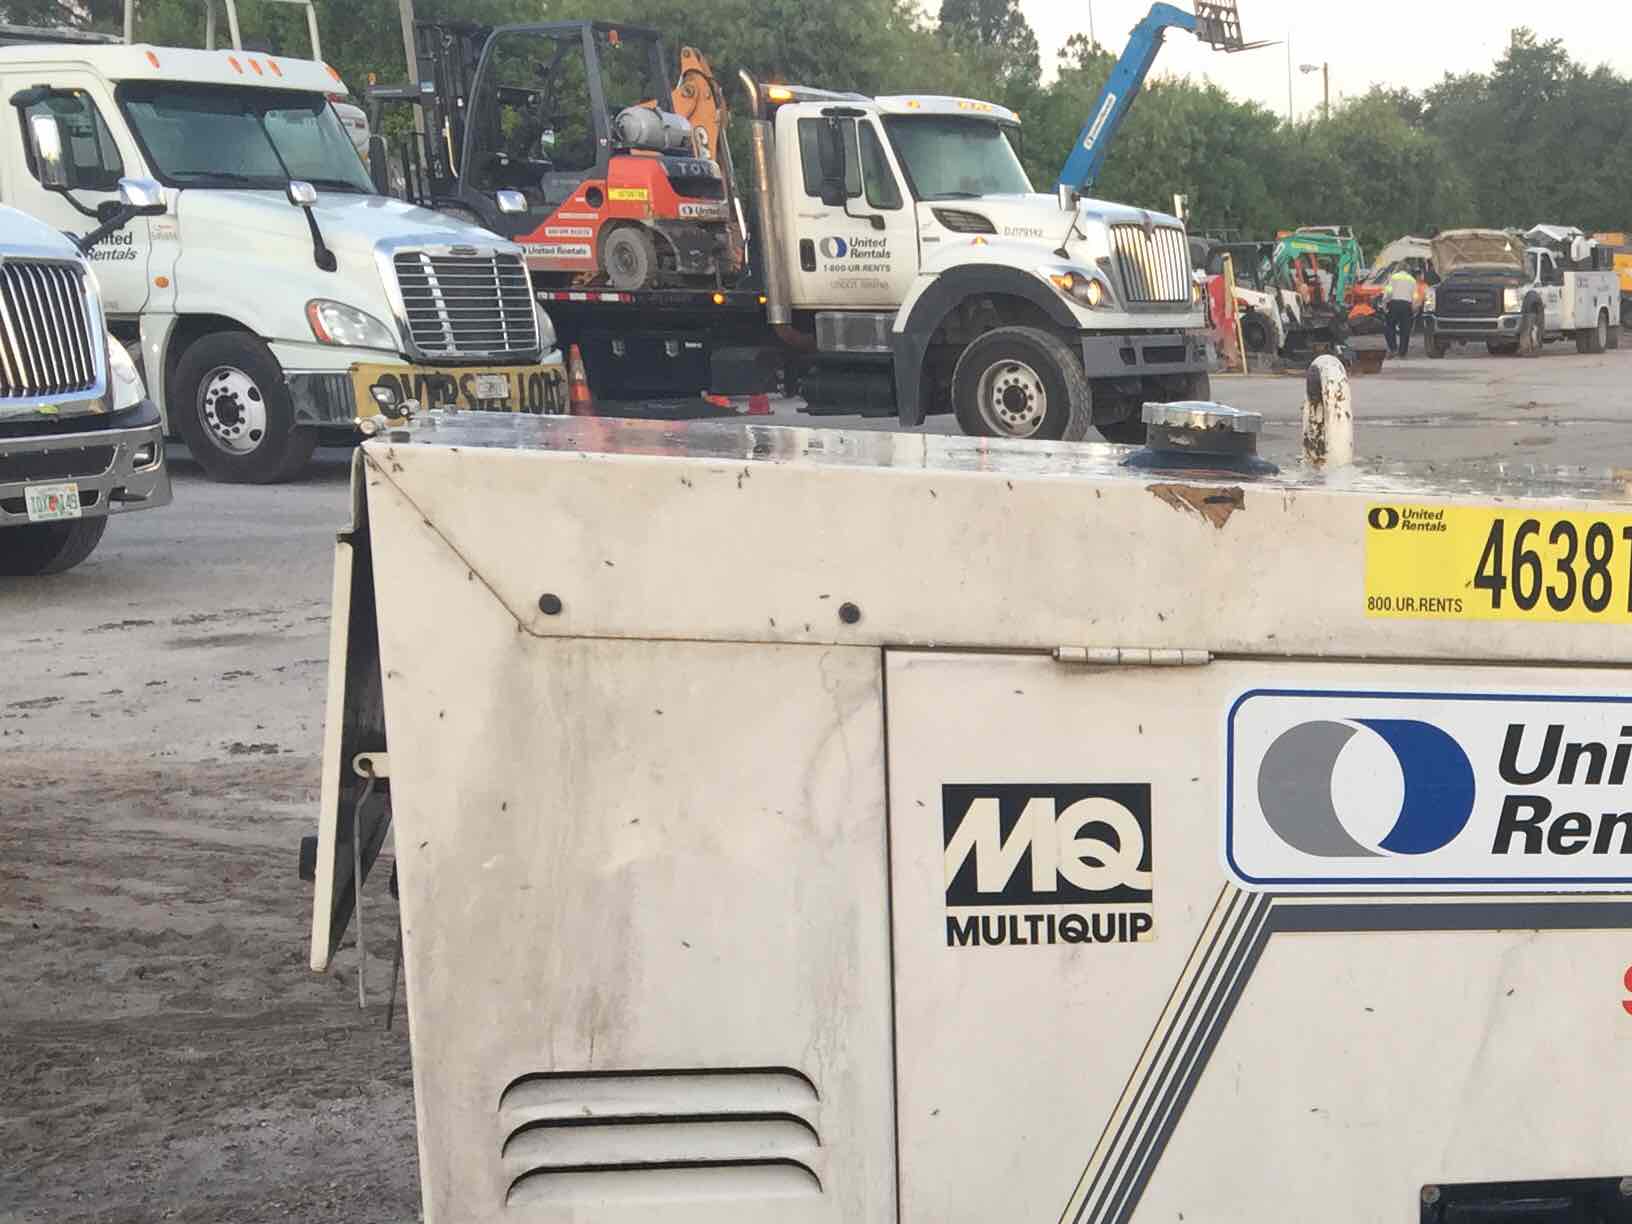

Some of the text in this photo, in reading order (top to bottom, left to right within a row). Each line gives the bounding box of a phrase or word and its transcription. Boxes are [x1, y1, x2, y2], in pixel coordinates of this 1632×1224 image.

[850, 239, 886, 249] United
[850, 249, 891, 260] Rentals
[1402, 509, 1444, 520] United
[1401, 520, 1447, 533] Rentals
[946, 912, 1152, 946] MULTIQUIP
